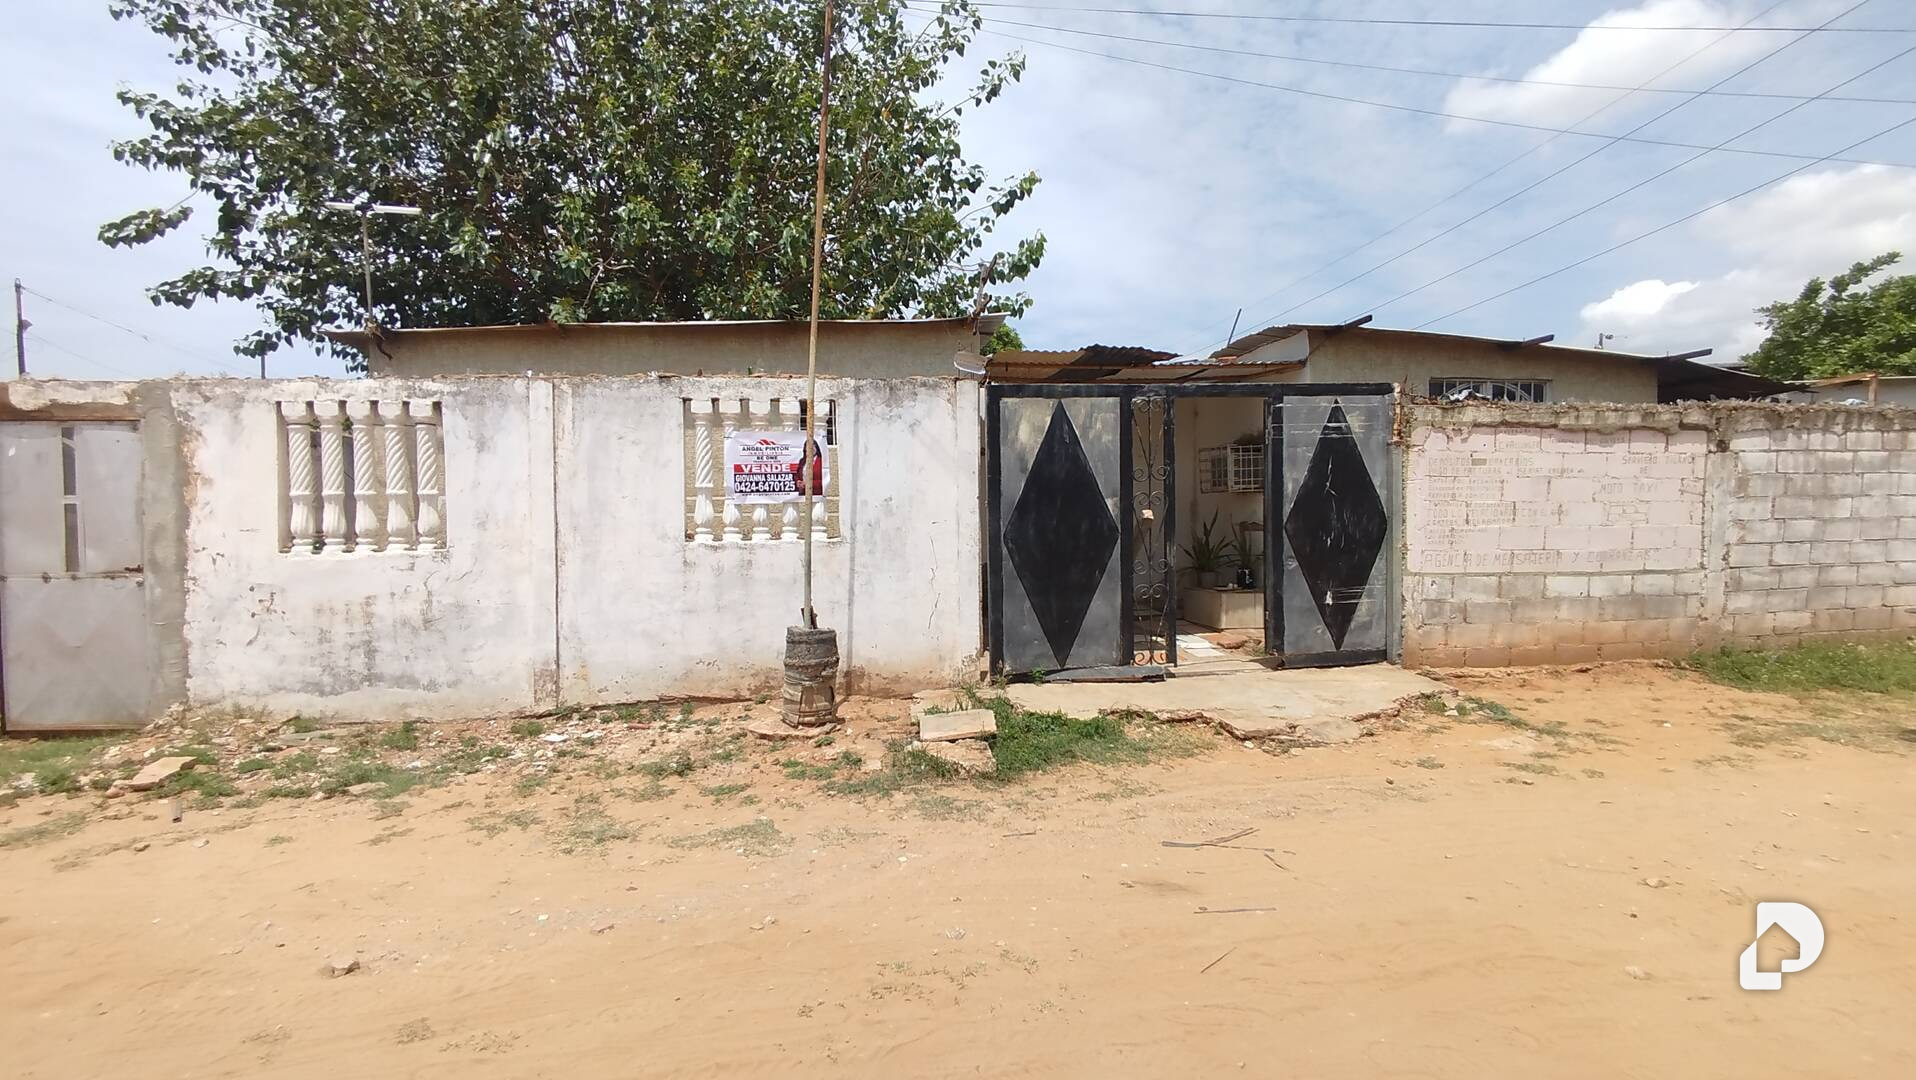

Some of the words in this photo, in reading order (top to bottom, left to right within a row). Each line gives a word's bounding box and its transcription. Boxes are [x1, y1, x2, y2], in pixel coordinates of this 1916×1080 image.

[740, 464, 791, 473] VENDE
[735, 474, 766, 482] GIOVANNA
[734, 481, 796, 492] 0424-6470125
[1475, 551, 1490, 566] DE
